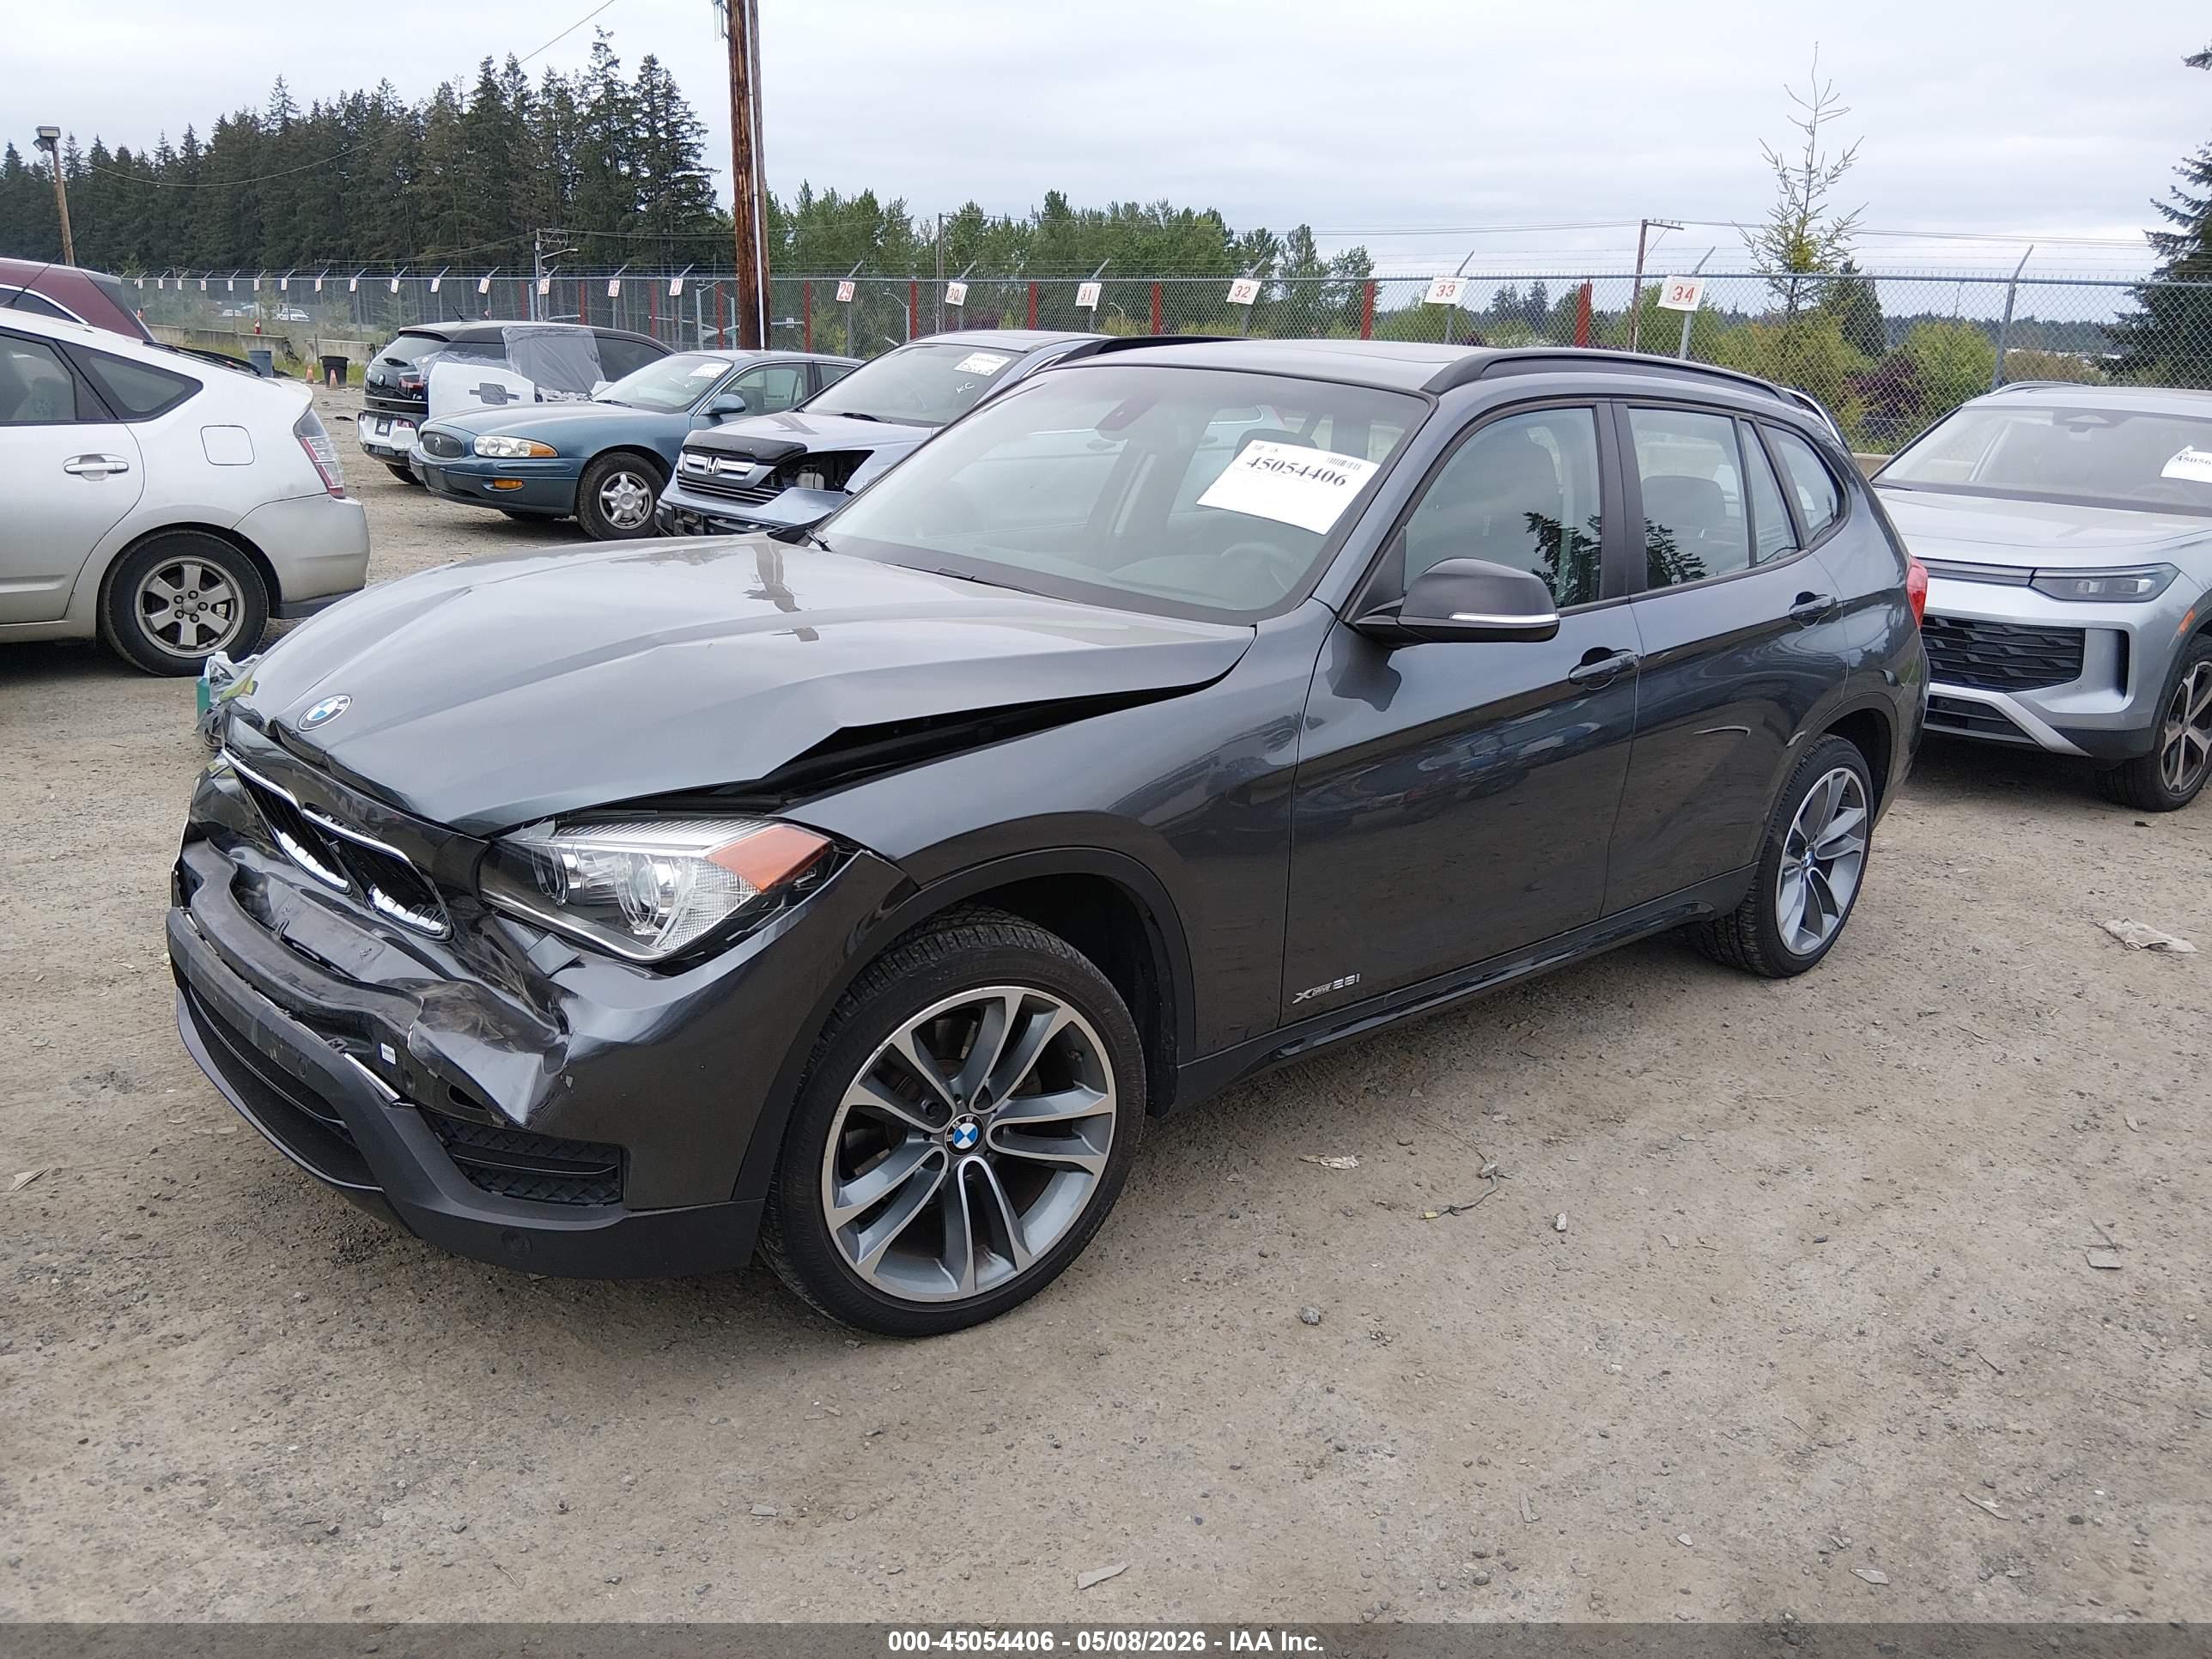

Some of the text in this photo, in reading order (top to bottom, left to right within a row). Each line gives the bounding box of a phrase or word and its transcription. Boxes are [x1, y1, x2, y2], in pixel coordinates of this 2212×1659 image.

[540, 280, 550, 293] 25
[609, 281, 619, 295] 26
[672, 280, 682, 294] 27
[837, 283, 853, 301] 29
[1234, 285, 1251, 298] 32
[1436, 284, 1455, 297] 33
[949, 288, 960, 301] 30
[1080, 288, 1092, 301] 31
[1673, 285, 1696, 303] 34
[1245, 456, 1351, 487] 45054406
[946, 1115, 975, 1142] BMW
